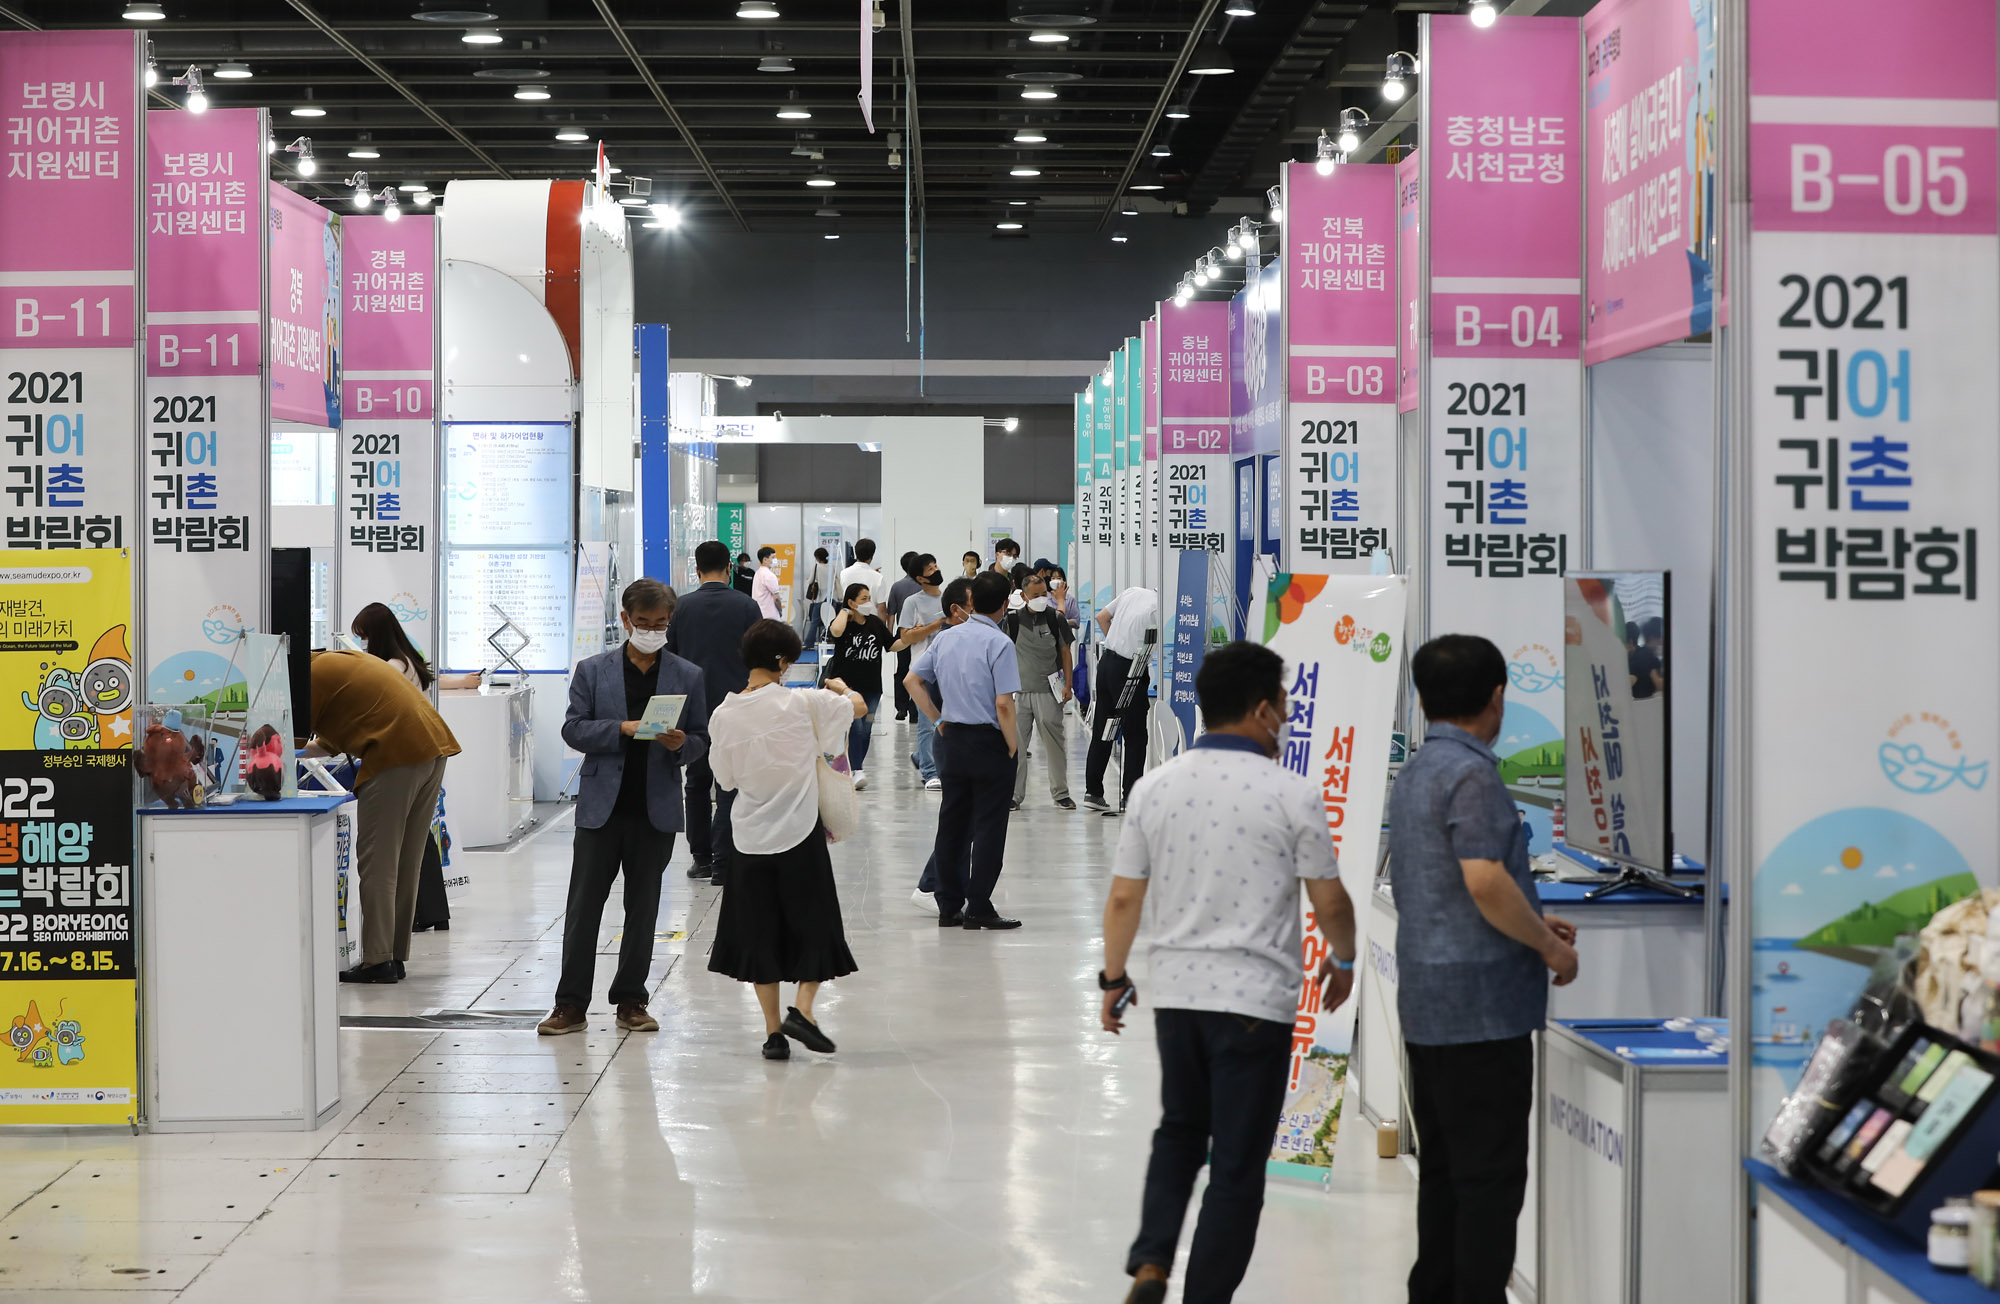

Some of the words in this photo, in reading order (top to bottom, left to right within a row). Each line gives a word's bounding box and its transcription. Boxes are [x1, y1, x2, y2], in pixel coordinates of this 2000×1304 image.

[22, 81, 104, 111] 보령시
[8, 116, 120, 145] 귀어귀촌
[1447, 115, 1565, 147] 충청남도
[8, 150, 118, 180] 지원센터
[164, 152, 233, 176] 보령시
[1446, 152, 1565, 184] 서천군청
[152, 181, 246, 206] 귀어귀촌
[1791, 143, 1968, 216] B-05
[152, 210, 245, 235] 지원센터
[1322, 217, 1364, 239] 전북
[370, 250, 406, 269] 경북
[1300, 243, 1386, 265] 귀어귀촌
[290, 268, 303, 314] 경북
[352, 272, 424, 291] 귀어귀촌
[1301, 268, 1385, 291] 지원센터
[352, 294, 424, 313] 지원센터
[1778, 274, 1908, 330] 2021
[16, 298, 110, 337] B-11
[1456, 305, 1562, 348] B-04
[160, 333, 239, 367] B-11
[271, 317, 296, 368] 귀어귀촌
[296, 326, 321, 375] 지원센터
[1182, 335, 1209, 350] 충남
[1169, 352, 1223, 366] 귀어귀촌
[8, 371, 82, 403] 2021
[1169, 368, 1223, 383] 지원센터
[1307, 365, 1383, 395] B-03
[1774, 348, 1910, 422] 귀어
[153, 396, 215, 422] 2021
[357, 387, 422, 413] B-10
[1447, 382, 1526, 416] 2021
[6, 413, 84, 457] 귀어
[351, 434, 400, 455] 2021
[472, 431, 487, 441] 면허
[500, 432, 544, 441] 허가어업현황
[1173, 430, 1221, 449] B-02
[1301, 420, 1357, 444] 2021
[152, 431, 216, 466] 귀어
[1445, 426, 1526, 471] 귀어
[350, 460, 401, 488] 귀어
[1169, 464, 1206, 480] 2021
[1300, 451, 1358, 483] 귀어
[1775, 436, 1912, 511] 귀촌
[6, 463, 85, 507] 귀촌
[152, 473, 218, 509] 귀촌
[1169, 485, 1206, 505] 귀어
[350, 492, 401, 520] 귀촌
[1300, 489, 1359, 521] 귀촌
[1445, 479, 1528, 525] 귀촌
[6, 515, 122, 549] 박람회
[1169, 508, 1207, 529] 귀촌
[152, 516, 249, 552] 박람회
[350, 524, 424, 552] 박람회
[1169, 533, 1224, 553] 박람회
[1300, 528, 1387, 559] 박람회
[1446, 533, 1567, 578] 박람회
[1776, 527, 1977, 600] 박람회
[13, 619, 73, 638] 미래가치
[43, 754, 83, 768] 정부승인
[86, 754, 126, 768] 국제행사
[0, 777, 55, 818] 22
[33, 913, 129, 931] BORYEONG
[33, 931, 52, 942] SEA
[53, 931, 76, 941] MUD
[76, 931, 129, 941] EXHIBITION
[1550, 1093, 1623, 1168] INFORMATION
